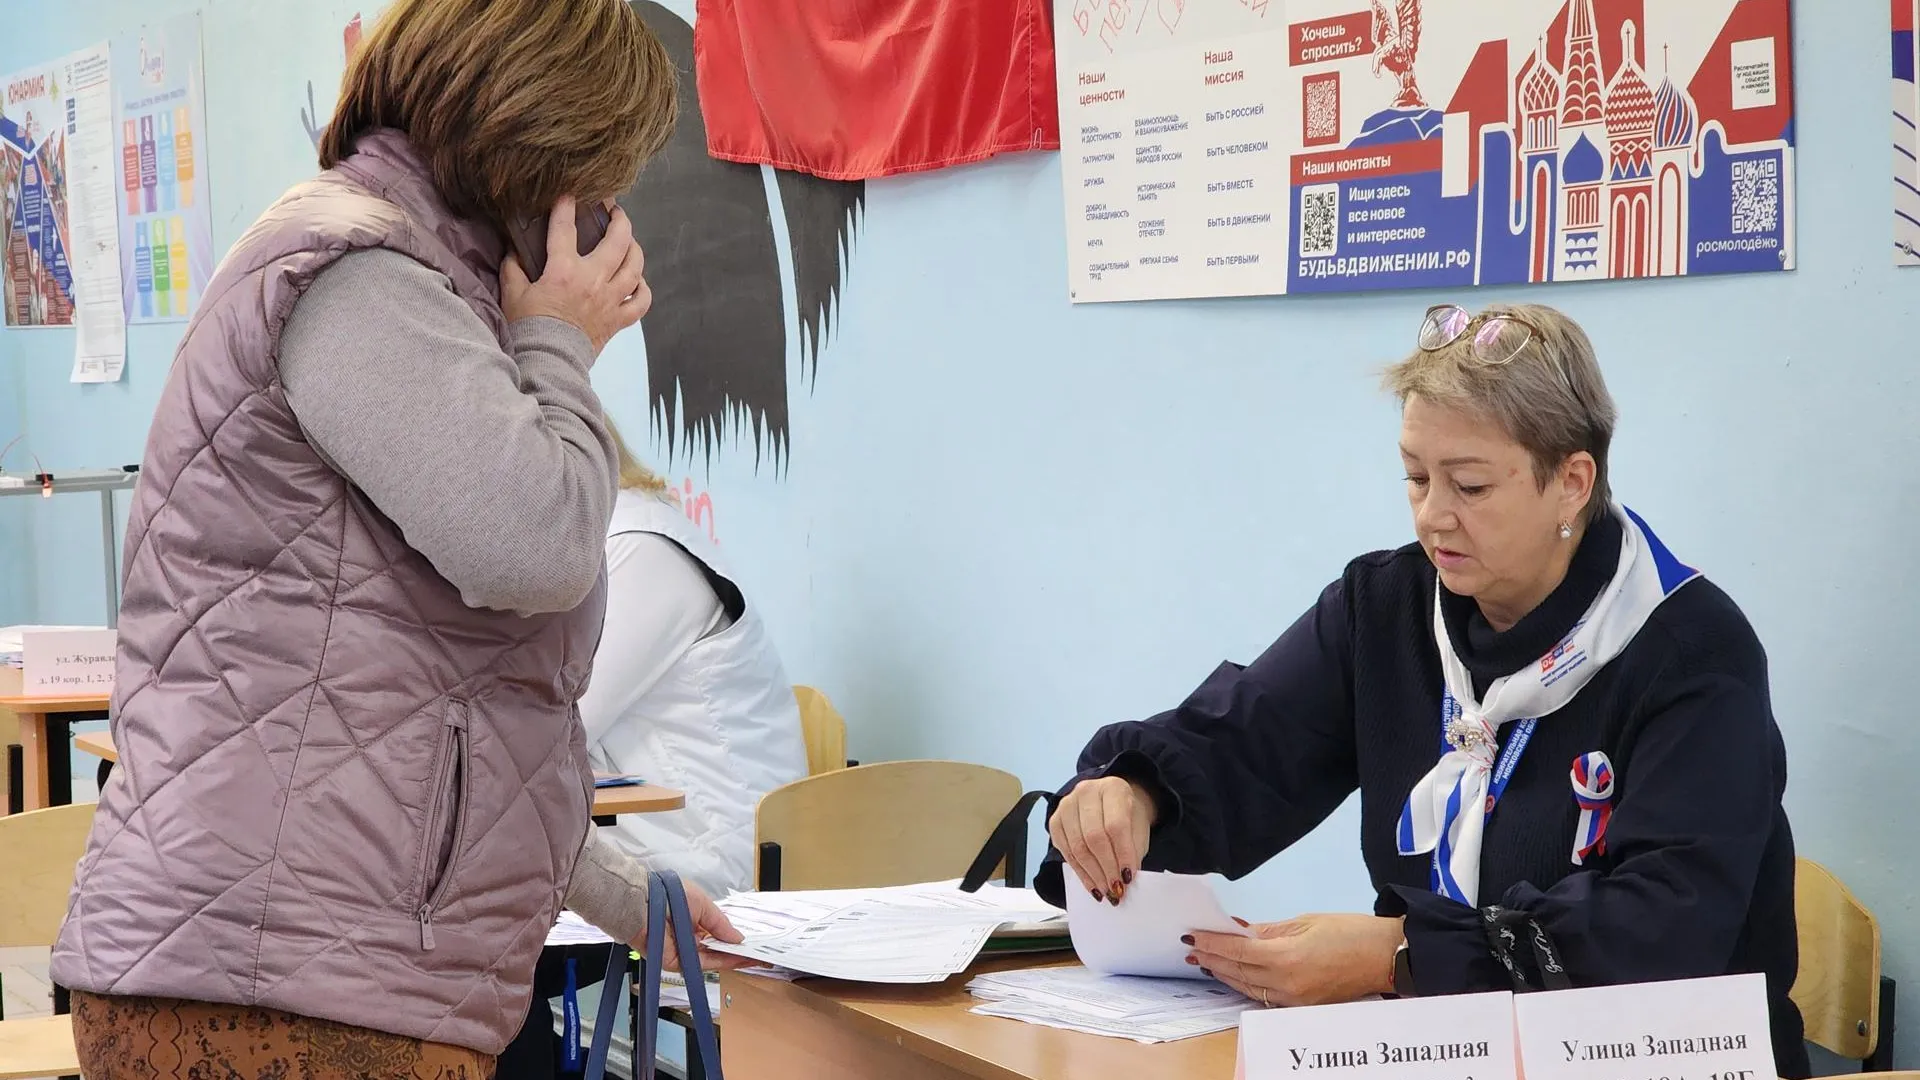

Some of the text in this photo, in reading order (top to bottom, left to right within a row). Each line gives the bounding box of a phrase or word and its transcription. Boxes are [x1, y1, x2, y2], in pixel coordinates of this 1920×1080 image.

[1301, 24, 1345, 43] Хочешь
[1301, 36, 1363, 62] спросить?
[1204, 50, 1233, 65] Наша
[1078, 72, 1106, 85] Наши
[1204, 70, 1244, 86] миссия
[1079, 89, 1125, 107] ценности
[1205, 104, 1265, 122] БЫТЬ С РОССИЕЙ
[1136, 145, 1162, 155] ЕДИНСТВО
[1206, 141, 1268, 157] БЫТЬ ЧЕЛОВЕКОМ
[1135, 153, 1183, 165] НАРОДОВ РОССИИ
[1303, 155, 1391, 176] Наши контакты
[1084, 177, 1105, 187] ДРУЖБА
[1137, 181, 1176, 193] ИСТОРИЧЕСКАЯ
[1207, 179, 1254, 193] БЫТЬ ВМЕСТЕ
[1349, 184, 1411, 202] Ищи здесь
[1207, 212, 1271, 228] БЫТЬ В ДВИЖЕНИИ
[1348, 207, 1406, 222] все новое
[1138, 219, 1165, 230] СЛУЖЕНИЕ
[1138, 229, 1166, 239] ОТЕЧЕСТВУ
[1347, 227, 1426, 243] и интересное
[1087, 239, 1104, 248] МЕЧТА
[1696, 235, 1778, 258] росмолодёжь
[1139, 255, 1179, 266] КРЕПКАЯ СЕМЬЯ
[1206, 254, 1260, 267] БЫТЬ ПЕРВЫМИ
[1298, 249, 1471, 279] БУДЬВДВИЖЕНИИ.РФ
[50, 675, 61, 685] 19
[63, 677, 84, 685] кор.
[87, 675, 95, 684] 1,
[97, 674, 105, 683] 2,
[1493, 729, 1524, 785] ИЗБИРАТЕЛЬНАЯ
[1502, 735, 1528, 780] МОСКОВСКОЙ
[1288, 1041, 1489, 1071] Улица Западная
[1561, 1034, 1748, 1062] Улица Западная
